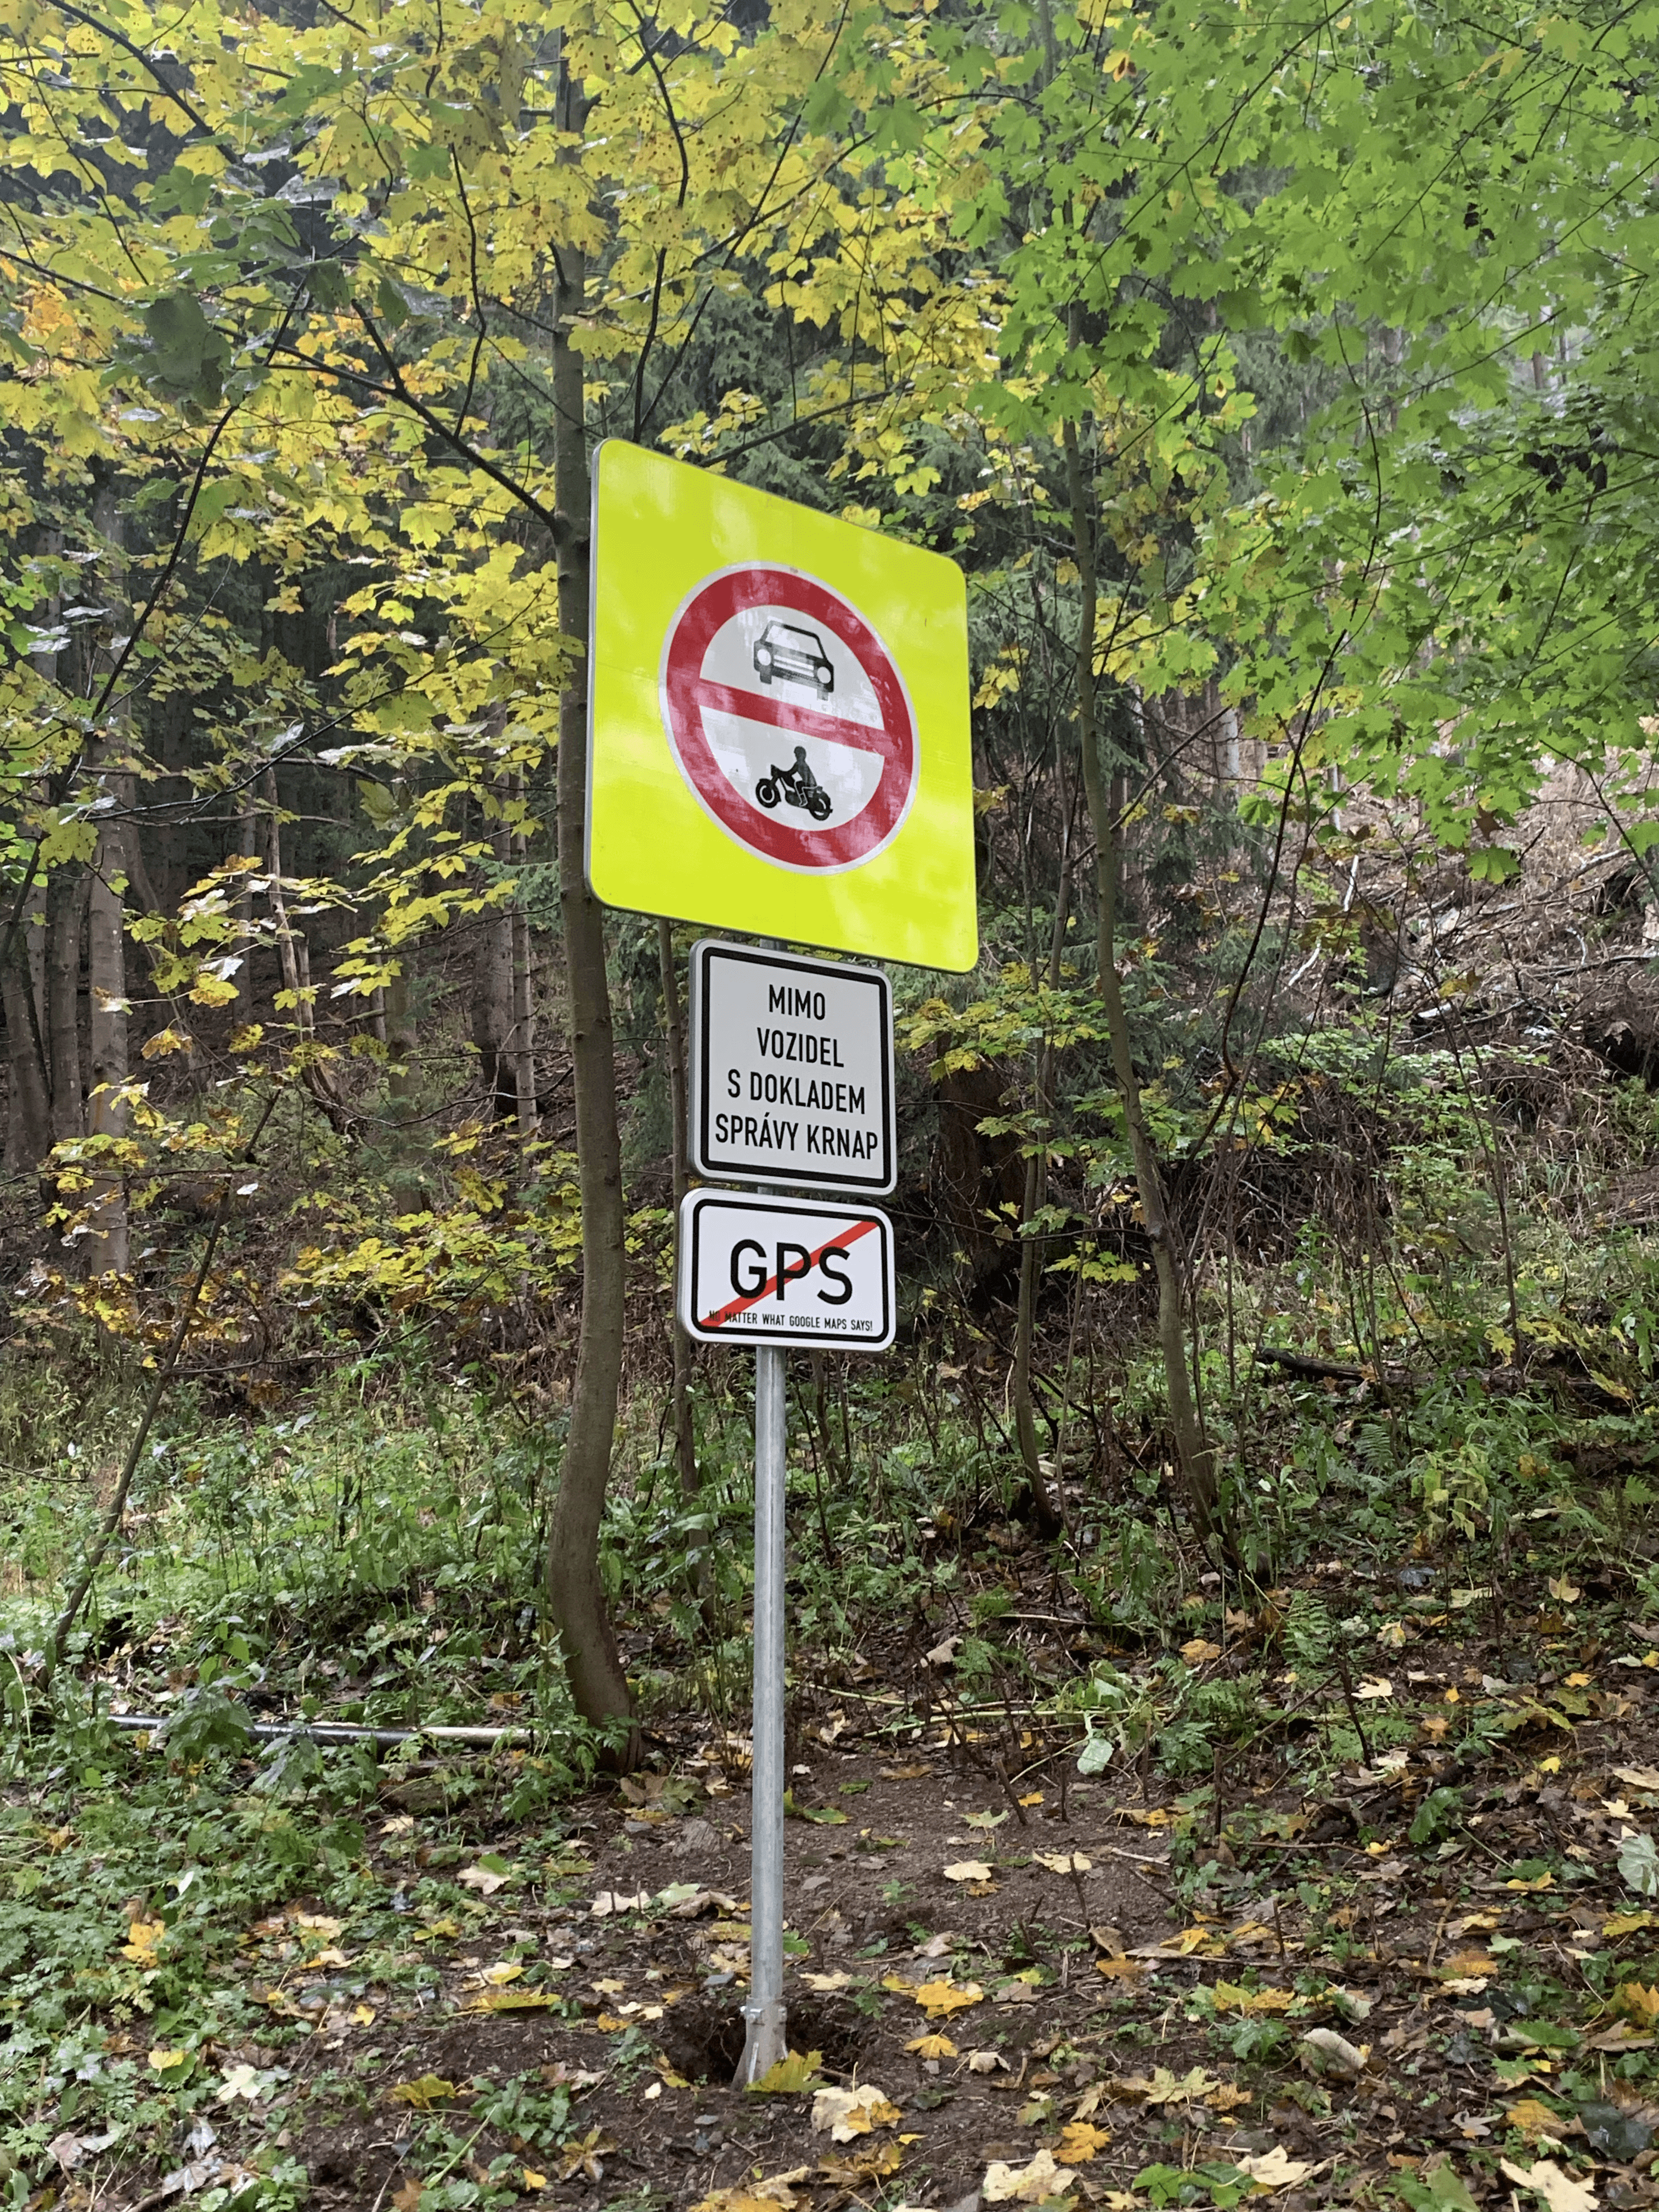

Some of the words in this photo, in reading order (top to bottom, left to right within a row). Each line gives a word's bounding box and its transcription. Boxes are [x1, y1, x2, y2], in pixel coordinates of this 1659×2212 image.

[769, 984, 826, 1020] MIMO
[757, 1027, 844, 1068] VOZIDEL
[727, 1069, 741, 1098] S
[750, 1071, 865, 1114] DOKLADEM
[715, 1112, 799, 1151] SPRÁVY
[806, 1124, 878, 1160] KRNAP
[730, 1239, 853, 1305] GPS
[725, 1311, 758, 1324] MATTER
[762, 1314, 785, 1327] WHAT
[789, 1316, 820, 1328] GOOGLE
[825, 1318, 847, 1330] MAPS
[851, 1319, 873, 1331] SAYS!
